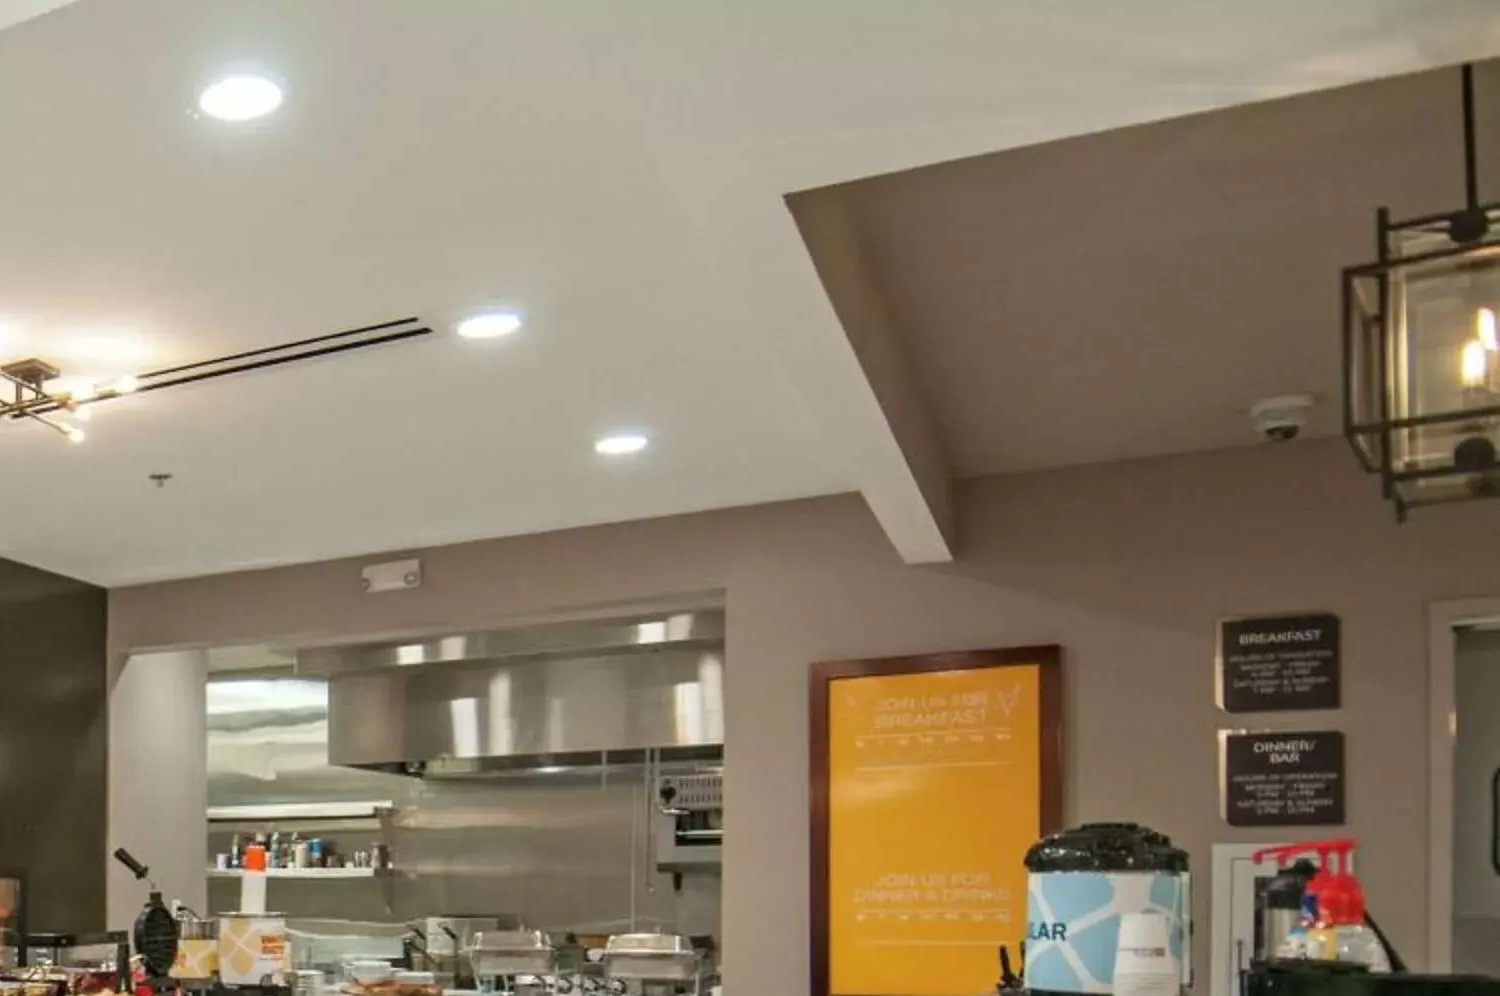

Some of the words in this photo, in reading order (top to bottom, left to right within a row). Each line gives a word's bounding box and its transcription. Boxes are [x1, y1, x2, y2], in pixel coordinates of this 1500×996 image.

[1239, 629, 1322, 645] BREAKFAST
[873, 708, 987, 729] BREAKFAST
[1268, 752, 1301, 764] BAR
